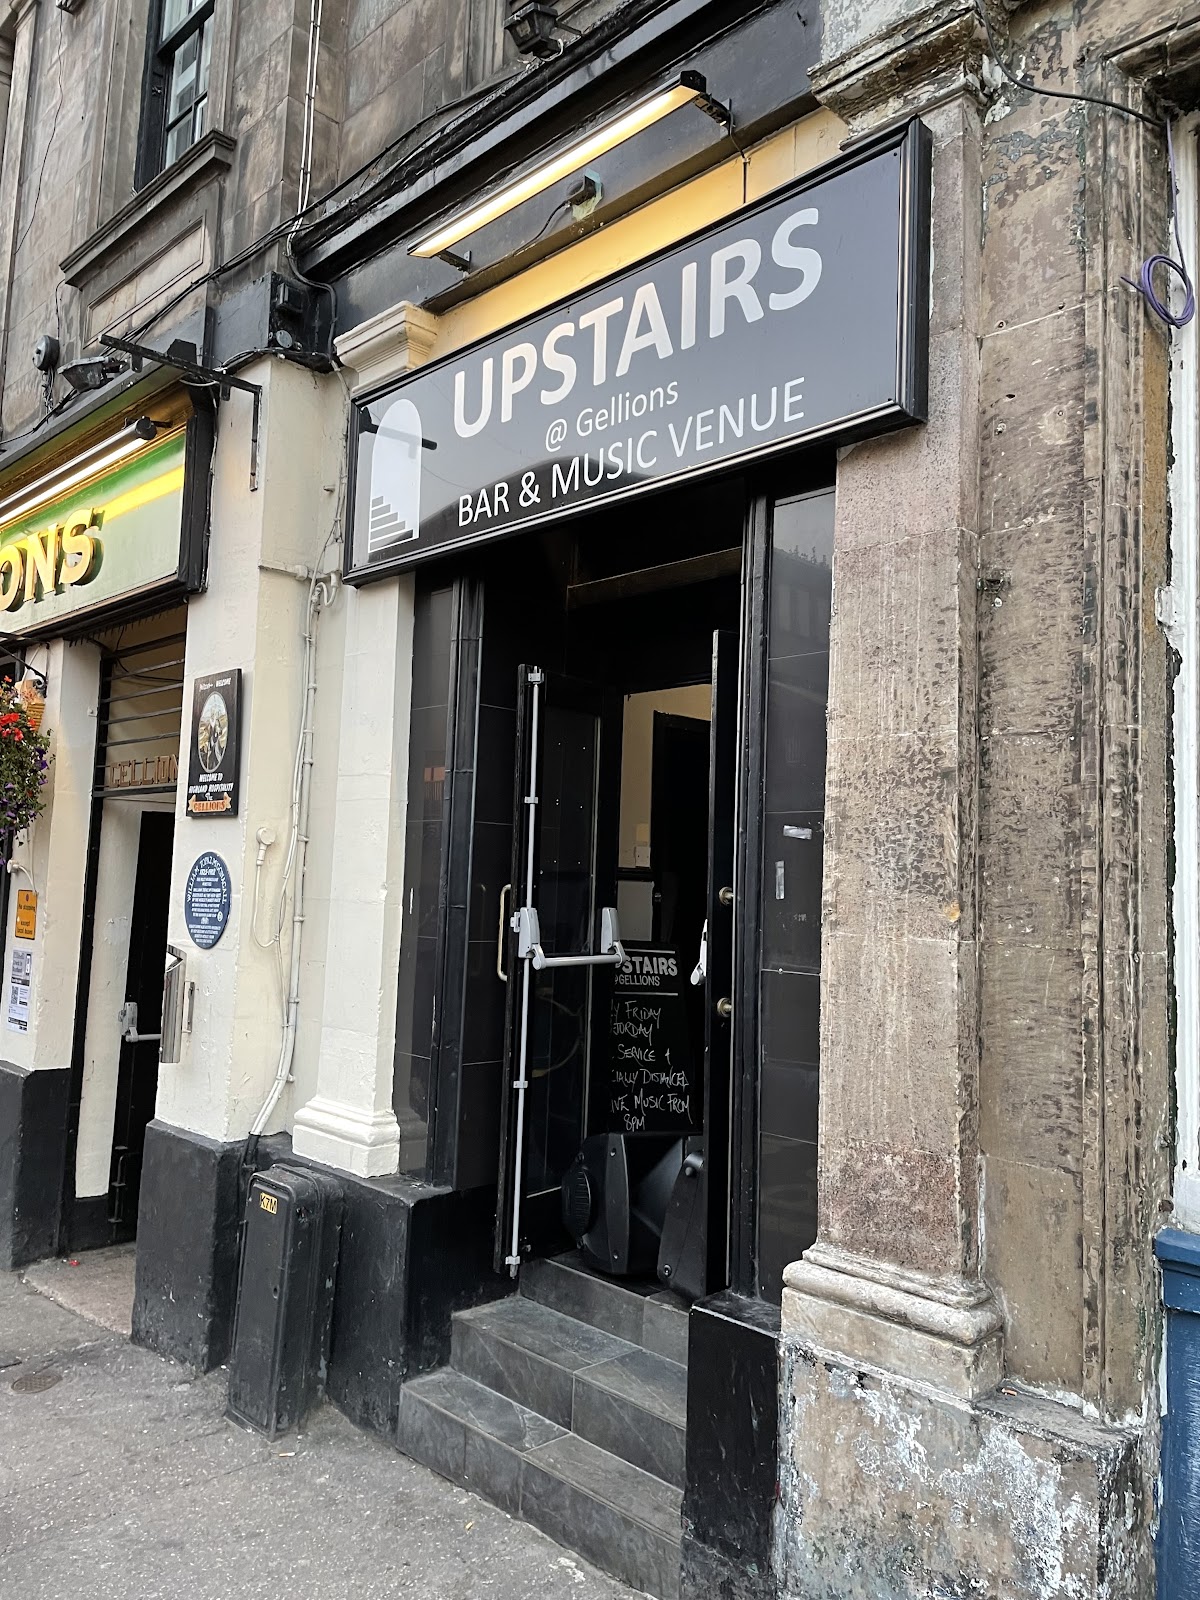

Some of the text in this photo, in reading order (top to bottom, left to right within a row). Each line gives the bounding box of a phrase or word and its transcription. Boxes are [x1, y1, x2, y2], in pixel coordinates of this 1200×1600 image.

[453, 207, 823, 439] UPSTAIRS
[545, 380, 680, 453] @ Gellions
[457, 377, 806, 528] BAR & MUSIC VENUE
[617, 1043, 657, 1067] SERVICE
[623, 1114, 646, 1132] 8PM
[634, 1087, 666, 1117] MUSIC
[667, 1093, 694, 1125] FROM
